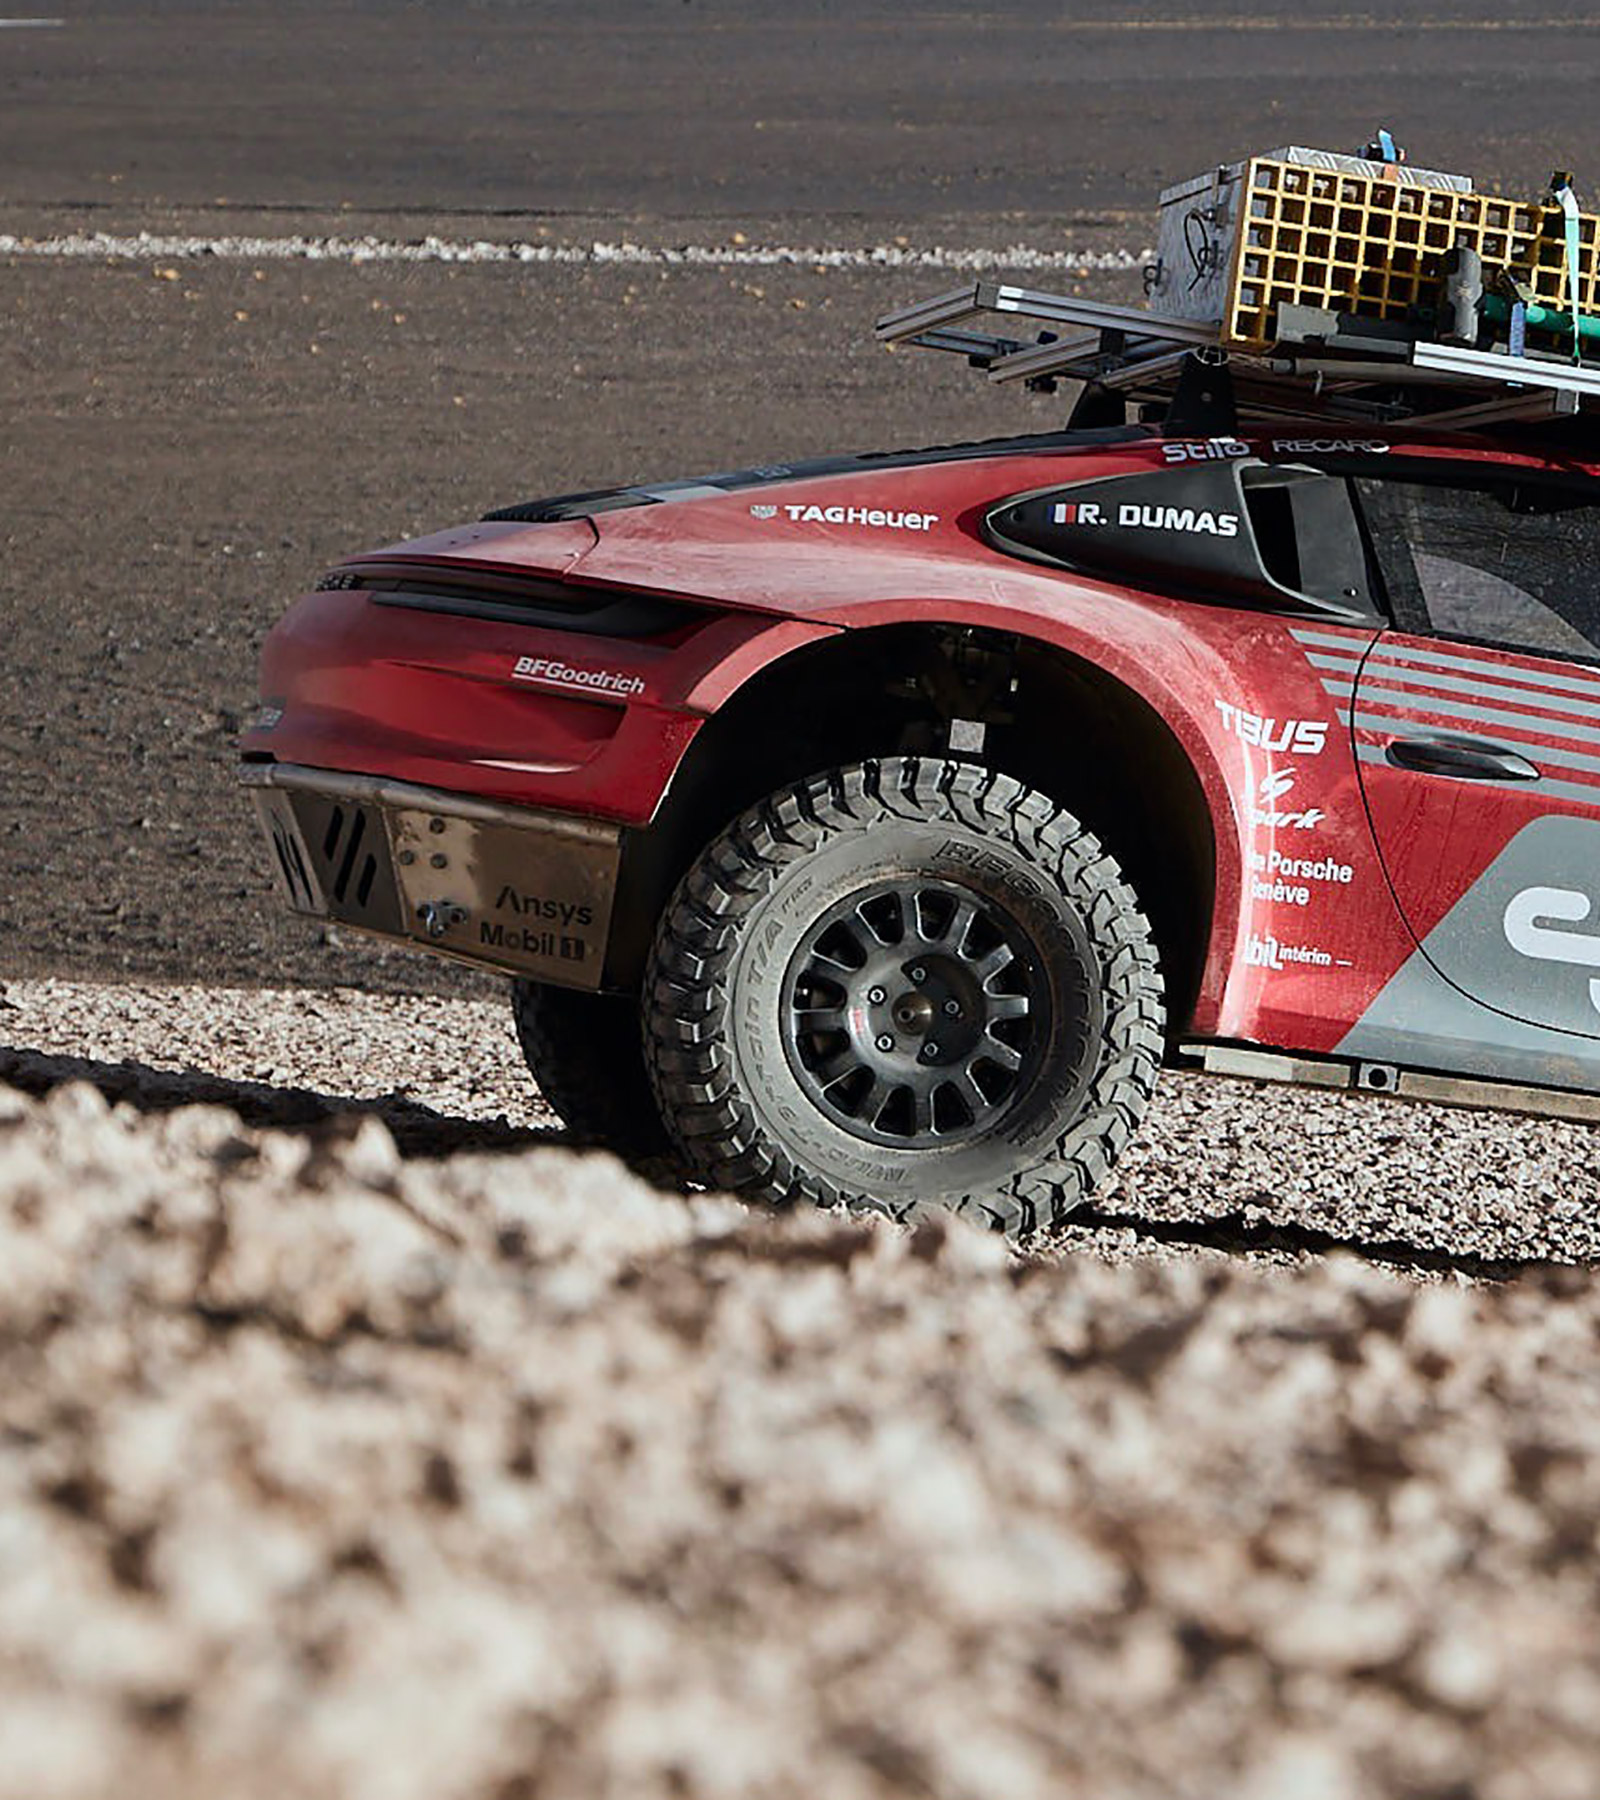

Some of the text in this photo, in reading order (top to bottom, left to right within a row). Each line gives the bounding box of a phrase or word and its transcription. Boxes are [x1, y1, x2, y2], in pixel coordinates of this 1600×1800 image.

[1161, 440, 1251, 463] Stilo
[1272, 439, 1389, 454] RECARO
[1078, 504, 1239, 537] R. DUMAS
[513, 656, 646, 694] BFGoodrich
[1268, 849, 1354, 883] Porsche
[495, 885, 593, 926] Ansys
[480, 921, 555, 956] Mobil
